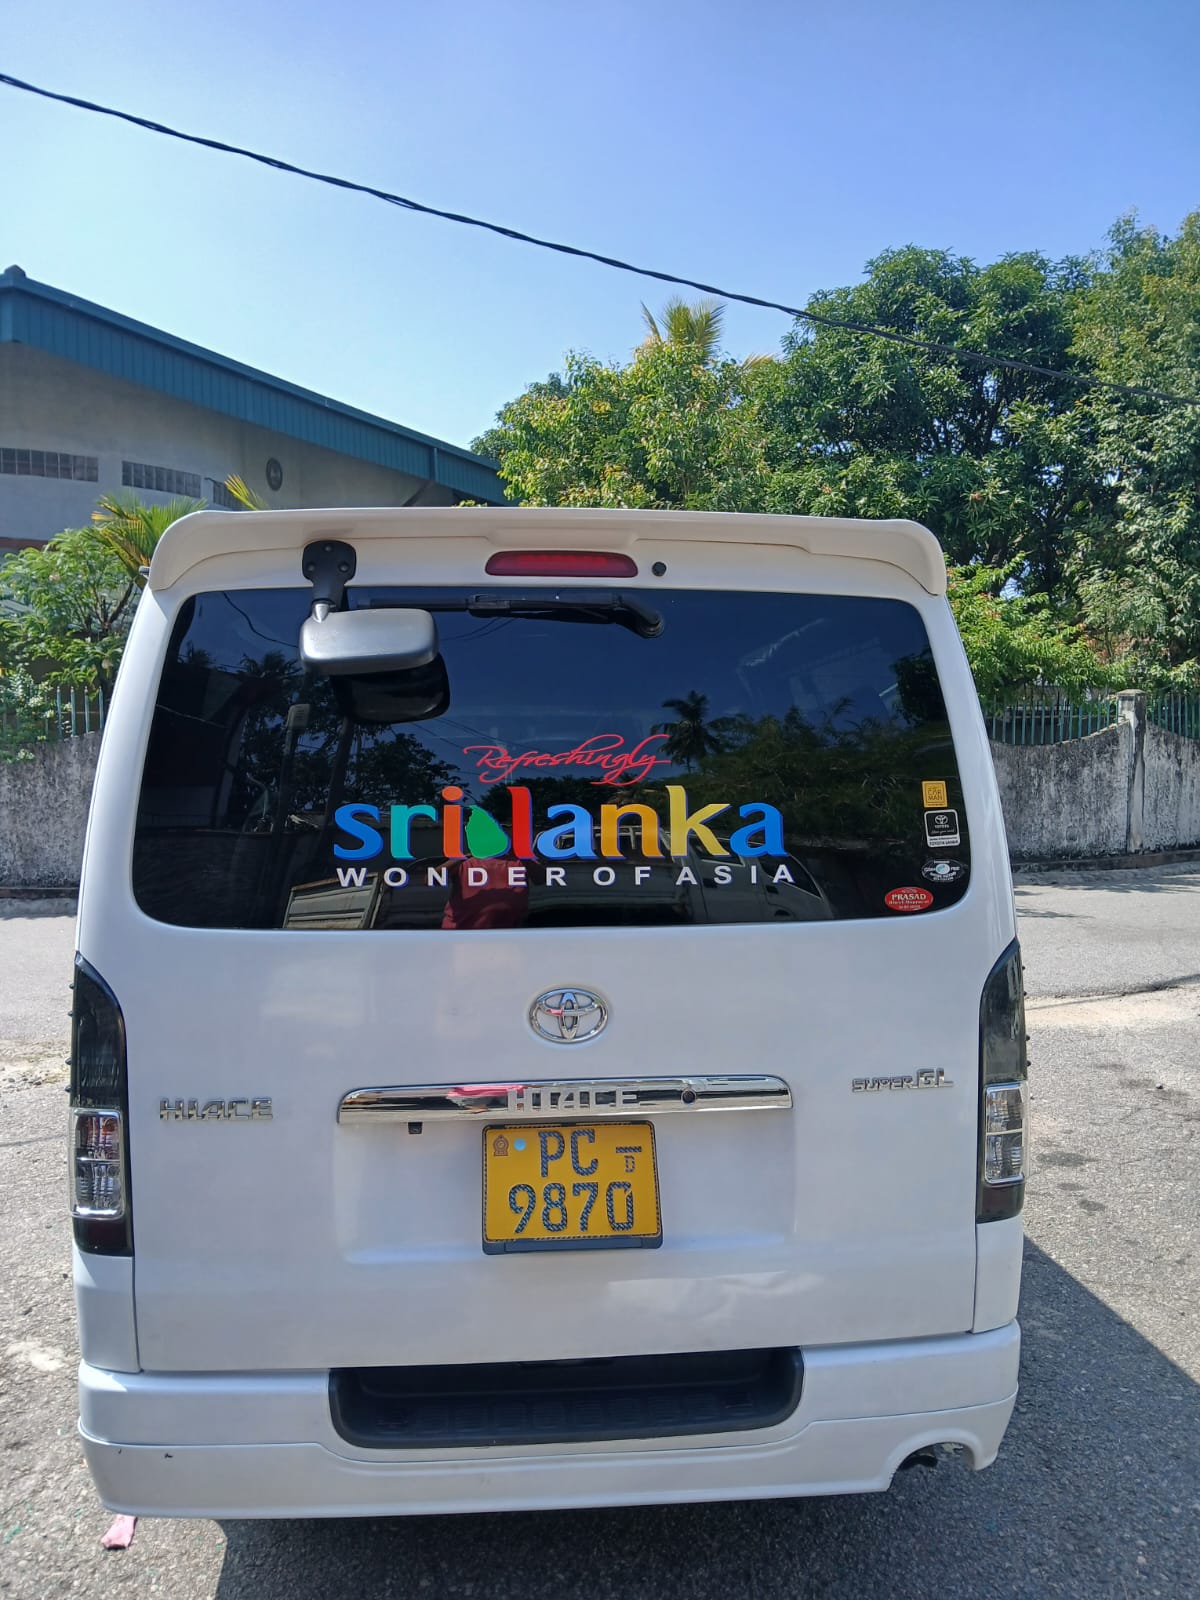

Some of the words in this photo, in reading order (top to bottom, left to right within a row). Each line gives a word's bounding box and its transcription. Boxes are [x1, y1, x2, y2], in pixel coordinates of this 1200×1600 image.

[463, 733, 672, 787] Refreshingly
[336, 867, 568, 888] WONDER
[593, 866, 651, 887] OF
[676, 864, 795, 886] ASIA
[891, 893, 927, 901] PRASAD
[159, 1098, 273, 1121] HIACE
[507, 1087, 640, 1114] HIACE
[537, 1128, 599, 1178] PC
[508, 1180, 634, 1234] 9870
